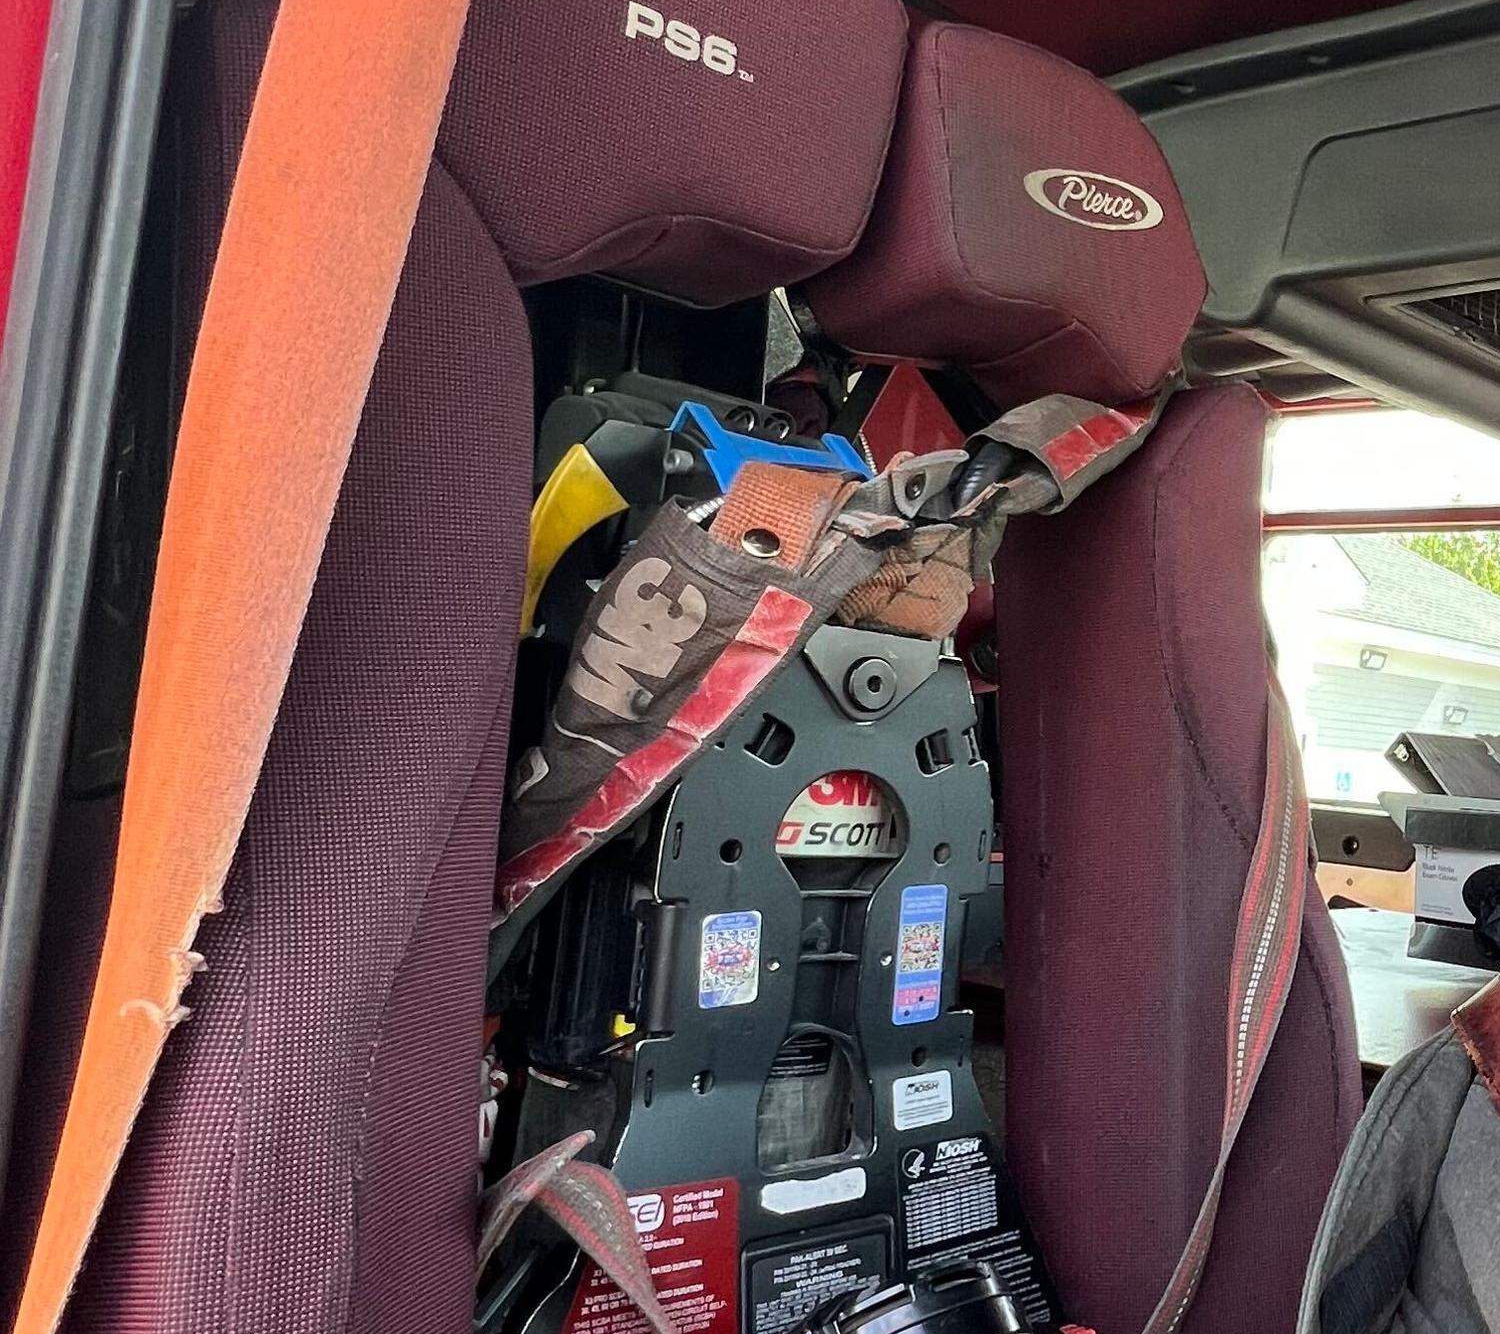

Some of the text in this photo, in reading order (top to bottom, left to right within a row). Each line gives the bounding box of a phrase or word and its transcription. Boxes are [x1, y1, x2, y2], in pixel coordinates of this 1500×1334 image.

[625, 0, 738, 75] PS6
[1057, 176, 1136, 220] Pierce
[569, 557, 708, 722] 3M
[804, 822, 886, 847] SCOTT
[936, 1138, 982, 1161] NIOSH
[795, 1270, 845, 1288] WARNING
